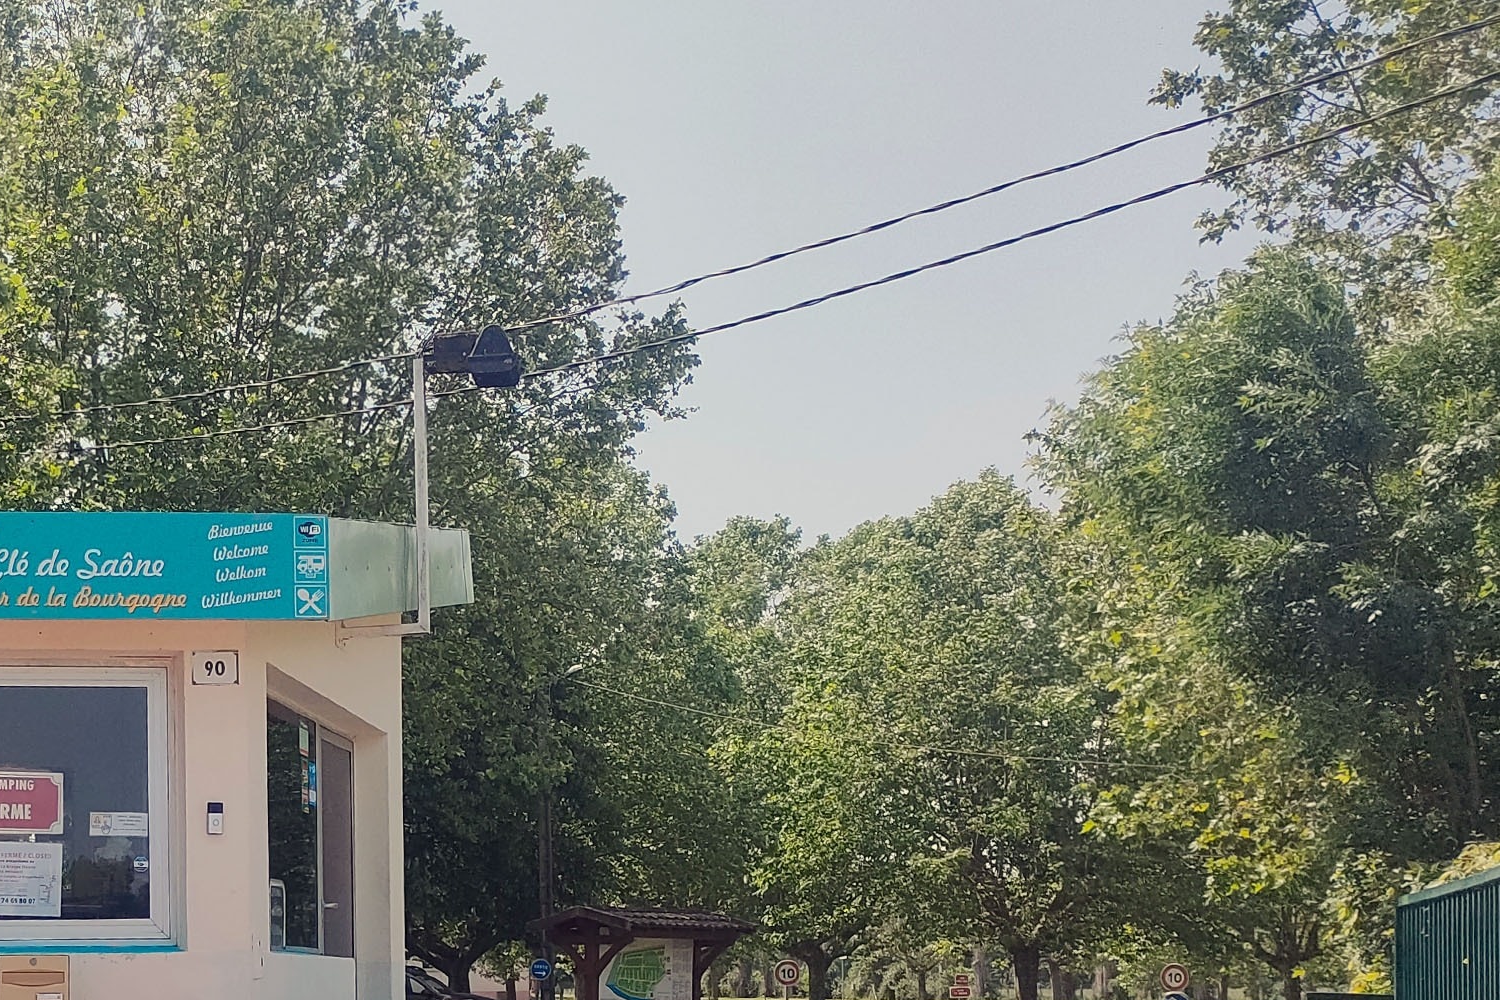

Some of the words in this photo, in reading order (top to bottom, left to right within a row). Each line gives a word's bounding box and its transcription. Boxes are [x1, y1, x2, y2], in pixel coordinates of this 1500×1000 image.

[207, 521, 273, 540] Bienvenue
[213, 544, 269, 561] Welcome
[35, 549, 69, 576] de
[76, 548, 165, 580] Saône
[215, 565, 267, 582] Welkom
[15, 586, 40, 607] de
[44, 586, 67, 607] la
[73, 585, 187, 613] Bourgogne
[201, 588, 281, 609] Willkommen
[204, 660, 226, 676] 90
[781, 968, 795, 979] 10
[1168, 972, 1182, 983] 10
